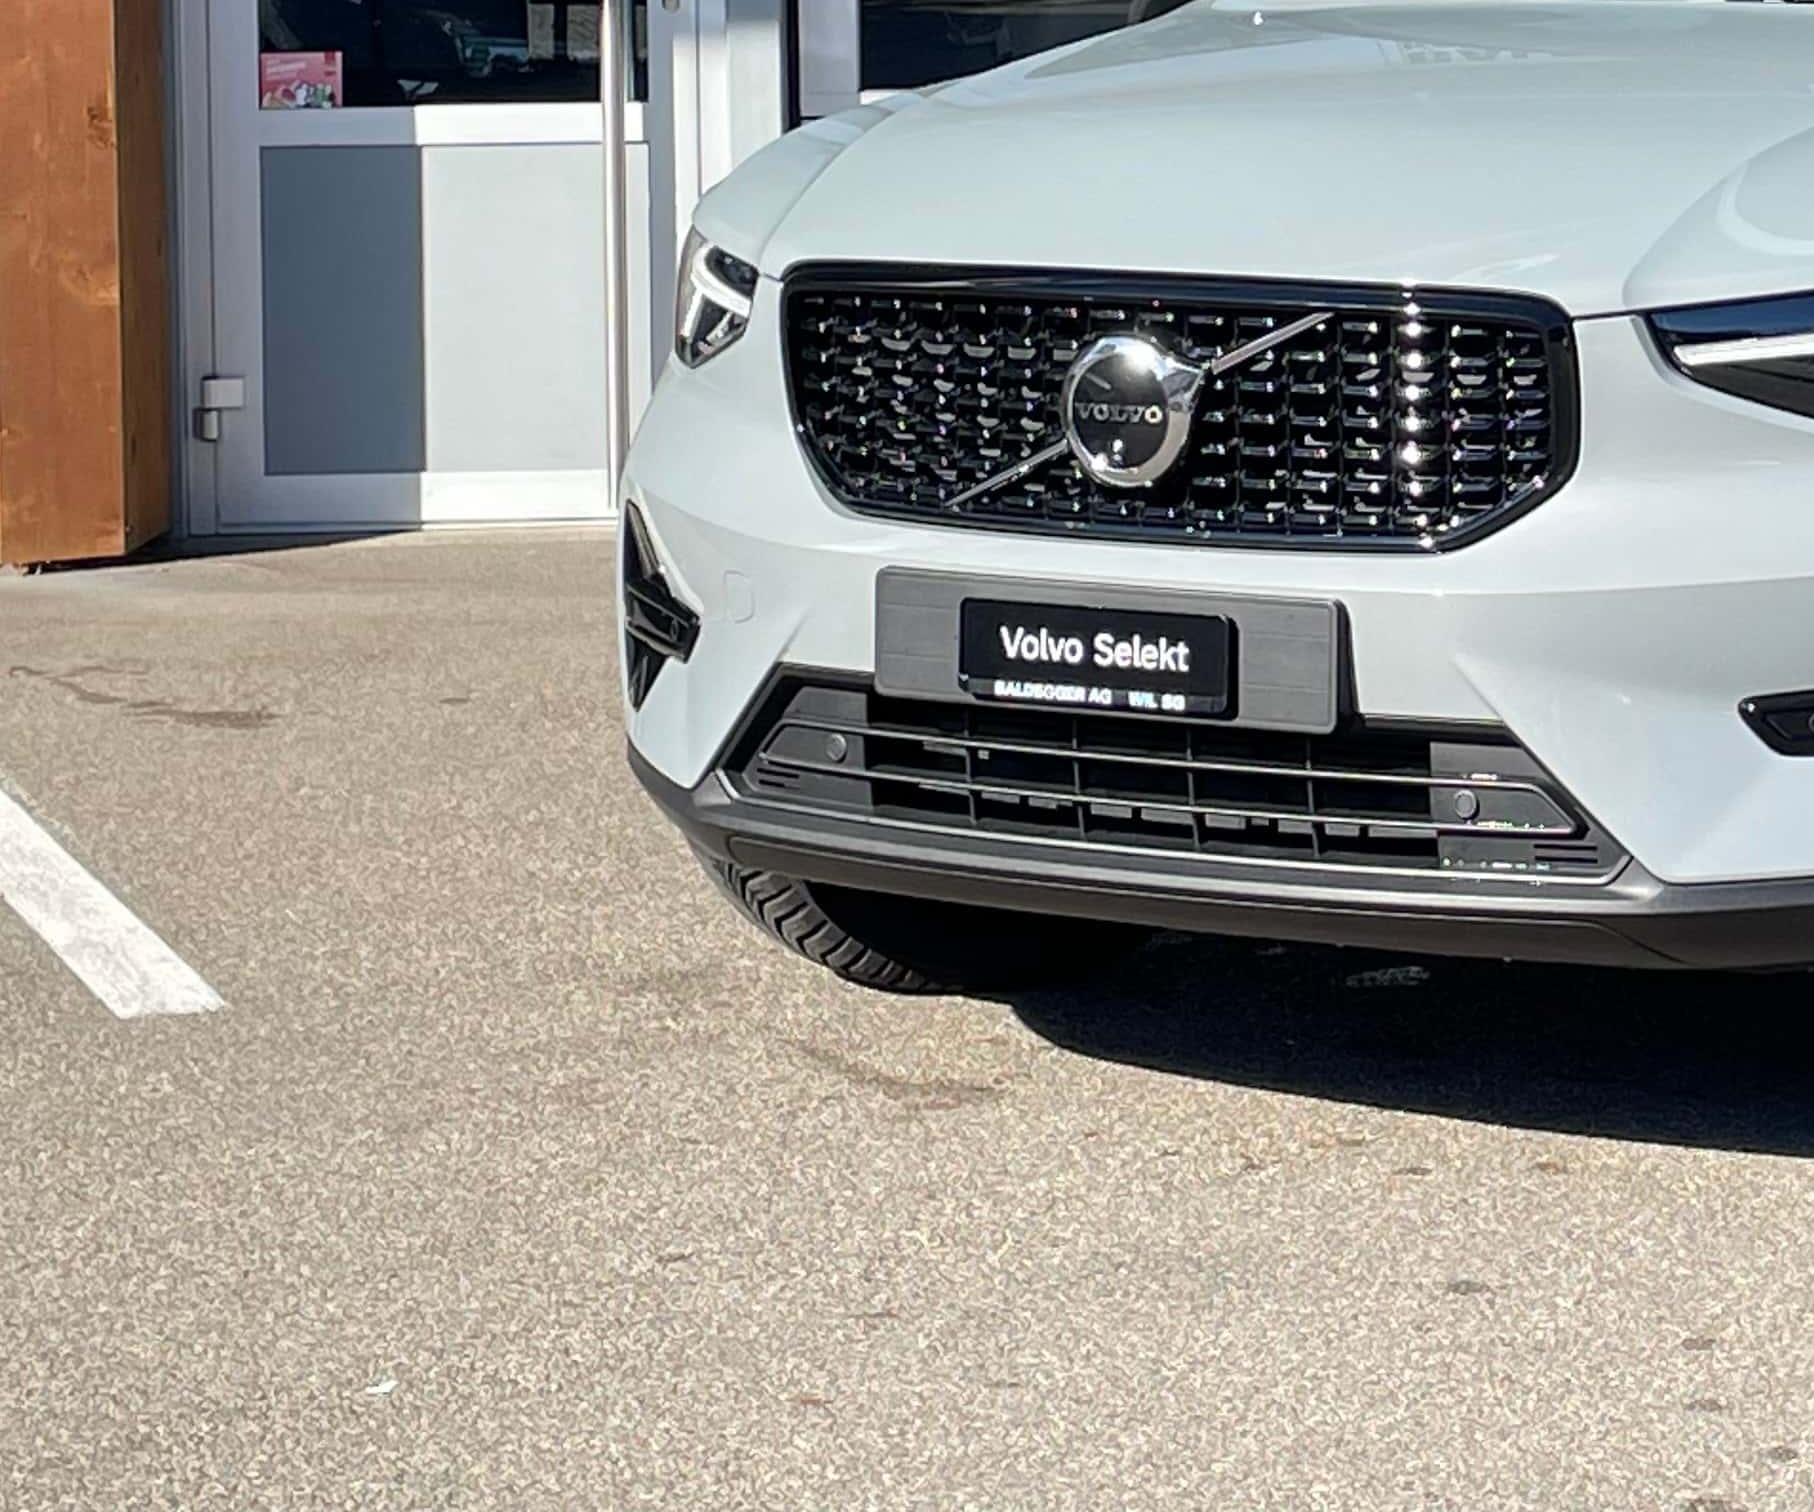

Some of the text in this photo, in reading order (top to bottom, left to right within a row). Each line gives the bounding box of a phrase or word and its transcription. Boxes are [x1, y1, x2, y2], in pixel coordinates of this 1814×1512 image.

[1074, 402, 1164, 425] VOLVO
[1000, 625, 1190, 673] Volvo Selekt
[1088, 687, 1112, 705] AG
